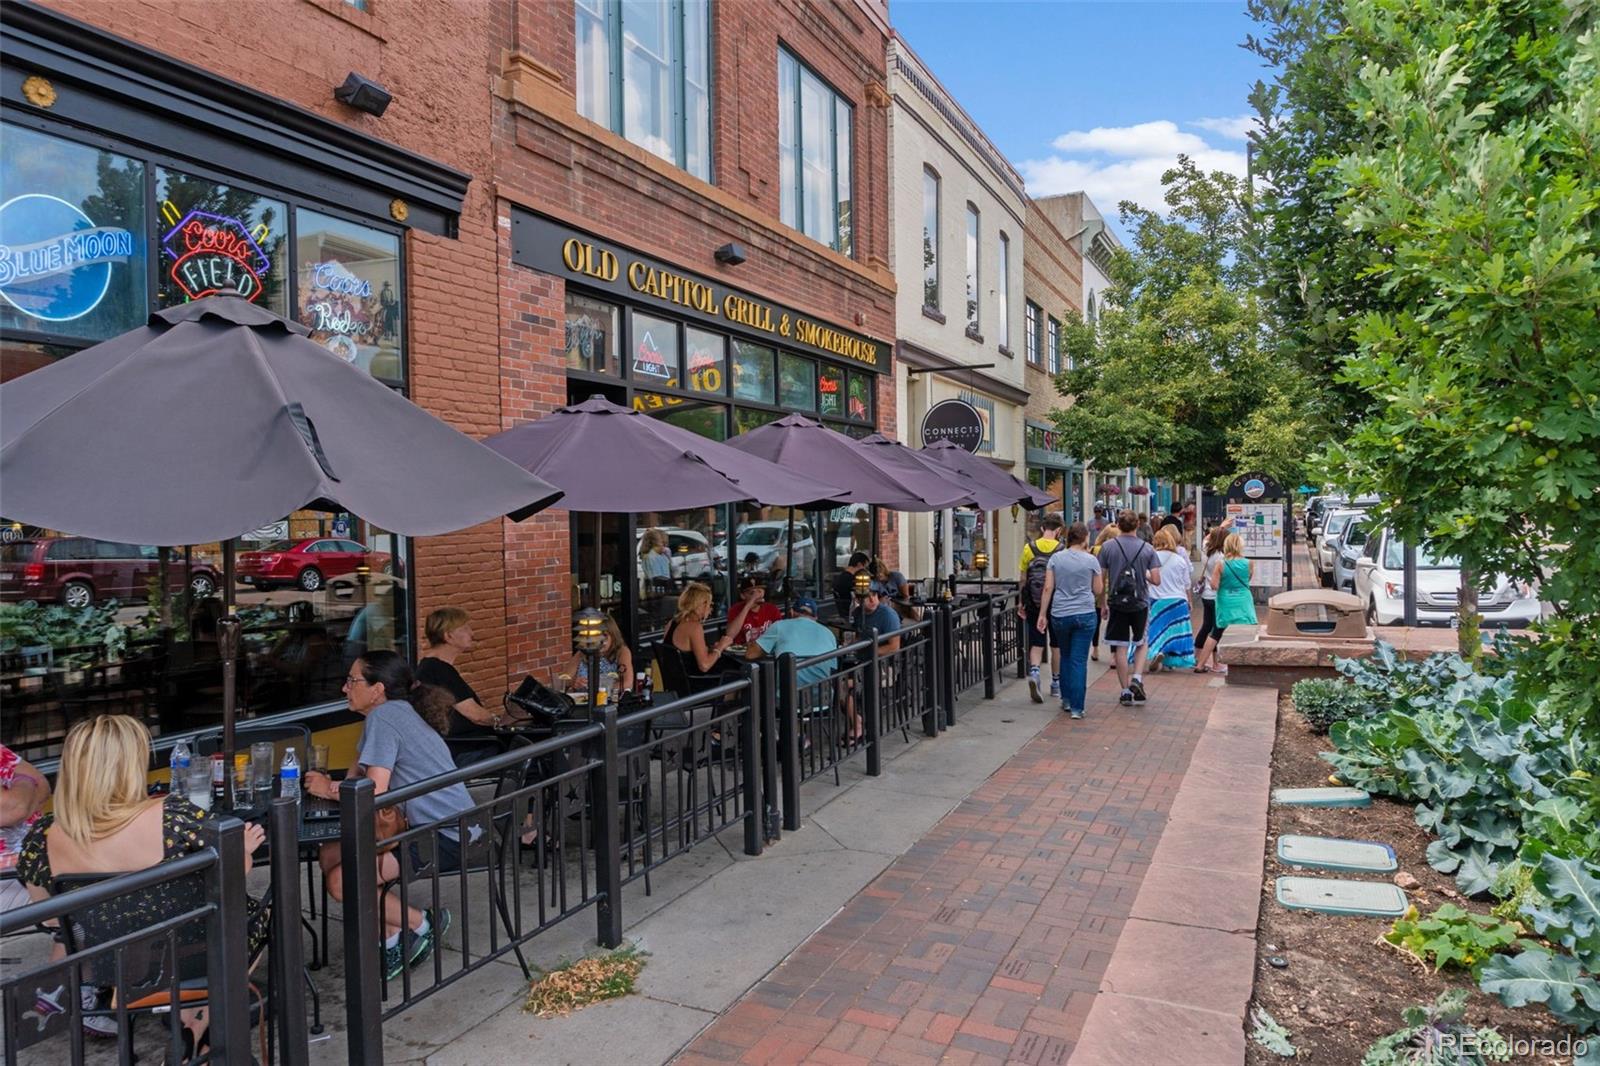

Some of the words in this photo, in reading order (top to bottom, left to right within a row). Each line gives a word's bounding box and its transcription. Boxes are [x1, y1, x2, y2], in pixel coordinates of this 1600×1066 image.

[64, 231, 132, 266] MOON
[183, 221, 252, 259] Coors
[314, 263, 373, 298] Coors
[563, 238, 619, 282] OLD
[628, 261, 719, 315] CAPITOL
[724, 294, 775, 332] GRILL
[779, 313, 791, 337] &
[795, 318, 877, 365] SMOKEHOUSE
[924, 425, 981, 436] CONNECTS
